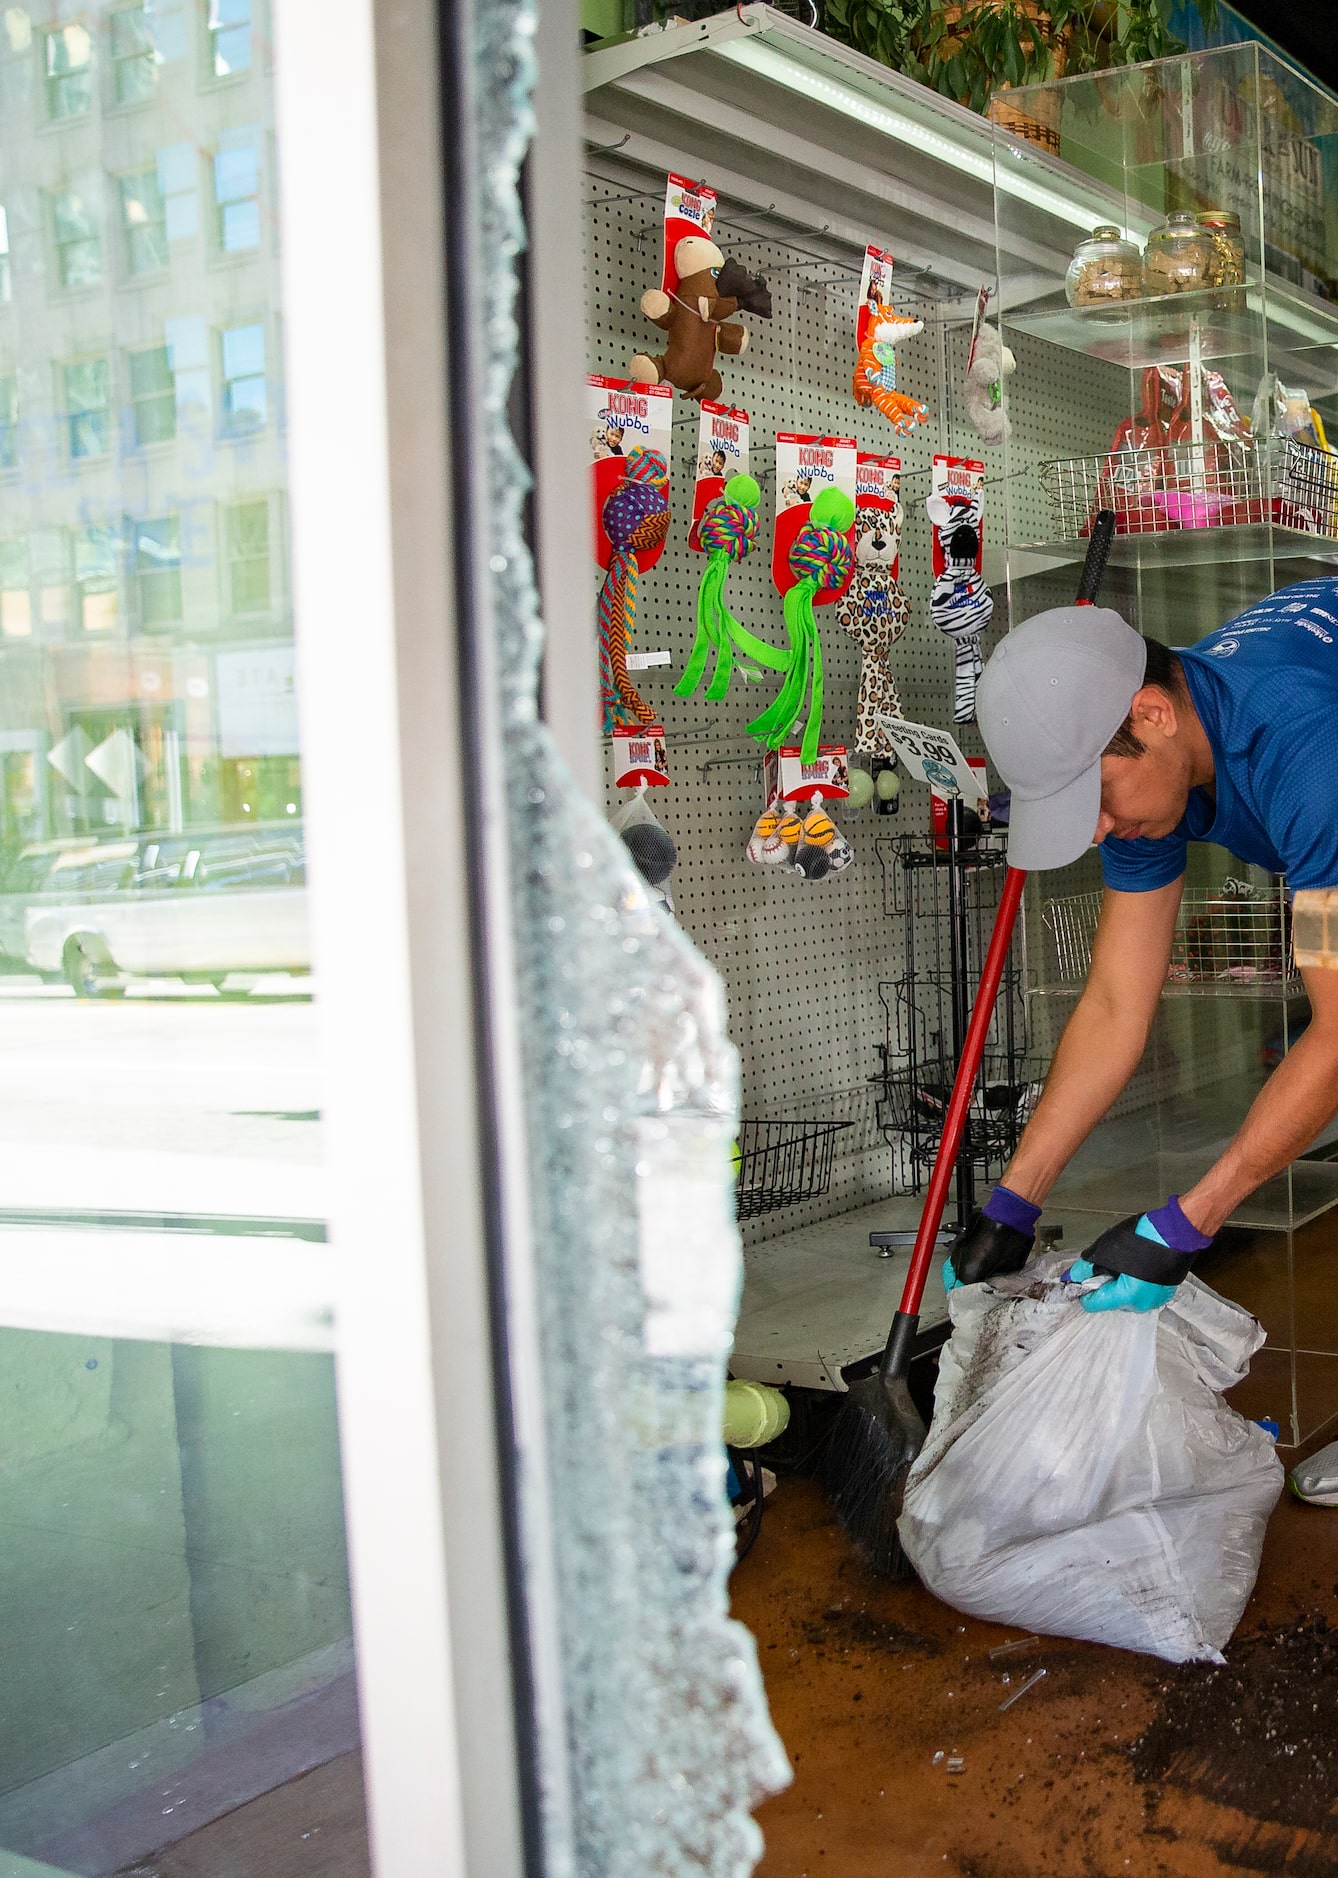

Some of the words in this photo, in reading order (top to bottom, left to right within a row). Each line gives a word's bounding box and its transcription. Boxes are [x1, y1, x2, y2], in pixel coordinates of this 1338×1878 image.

[681, 192, 702, 212] KONG
[608, 392, 649, 418] KONG
[607, 414, 650, 434] Wubba
[712, 417, 739, 443] KONG
[710, 438, 740, 458] Wubba
[799, 447, 834, 467] KONG
[797, 465, 835, 482] Wubba
[947, 470, 971, 487] KONG
[946, 486, 972, 499] Wubba
[880, 719, 921, 740] Greeting
[920, 730, 950, 746] Cards
[890, 731, 958, 767] $3.99
